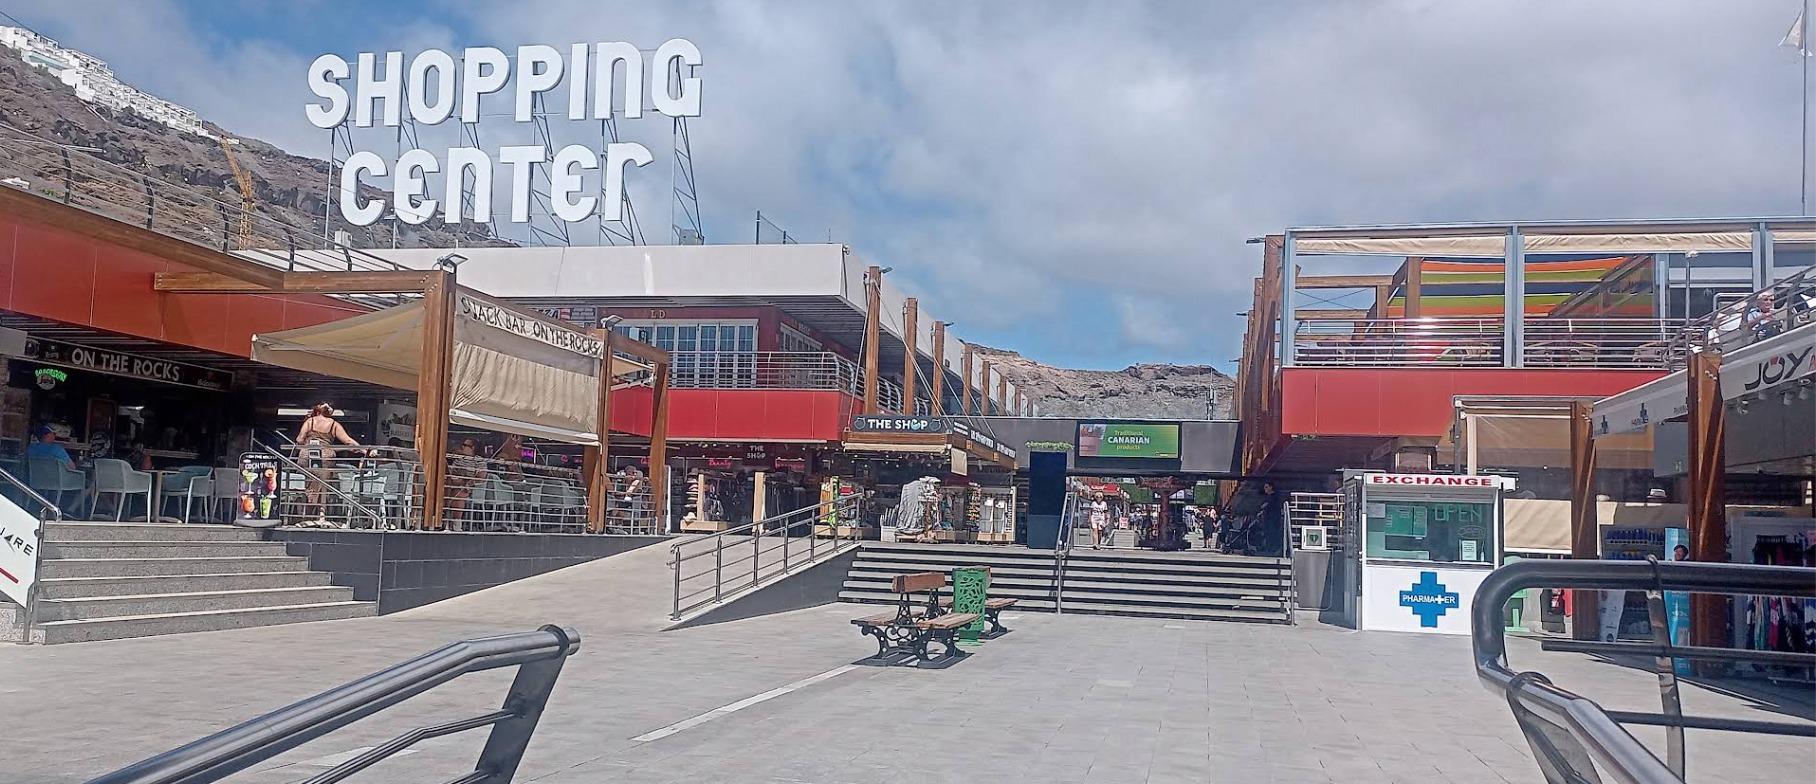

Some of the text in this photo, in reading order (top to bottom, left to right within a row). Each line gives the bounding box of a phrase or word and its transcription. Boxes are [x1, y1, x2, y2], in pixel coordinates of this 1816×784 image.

[305, 38, 703, 129] SHOPPING
[340, 142, 655, 227] CENTER
[533, 321, 548, 341] ON
[549, 327, 568, 347] THE
[71, 347, 95, 368] ON
[101, 353, 129, 374] THE
[133, 359, 180, 382] ROCKS
[1744, 346, 1814, 391] JOY
[868, 418, 928, 431] THE SHOP
[1107, 436, 1150, 445] CANARIAN
[746, 452, 766, 460] SHOP
[1373, 476, 1492, 486] EXCHANGE
[1434, 503, 1483, 522] OPEN
